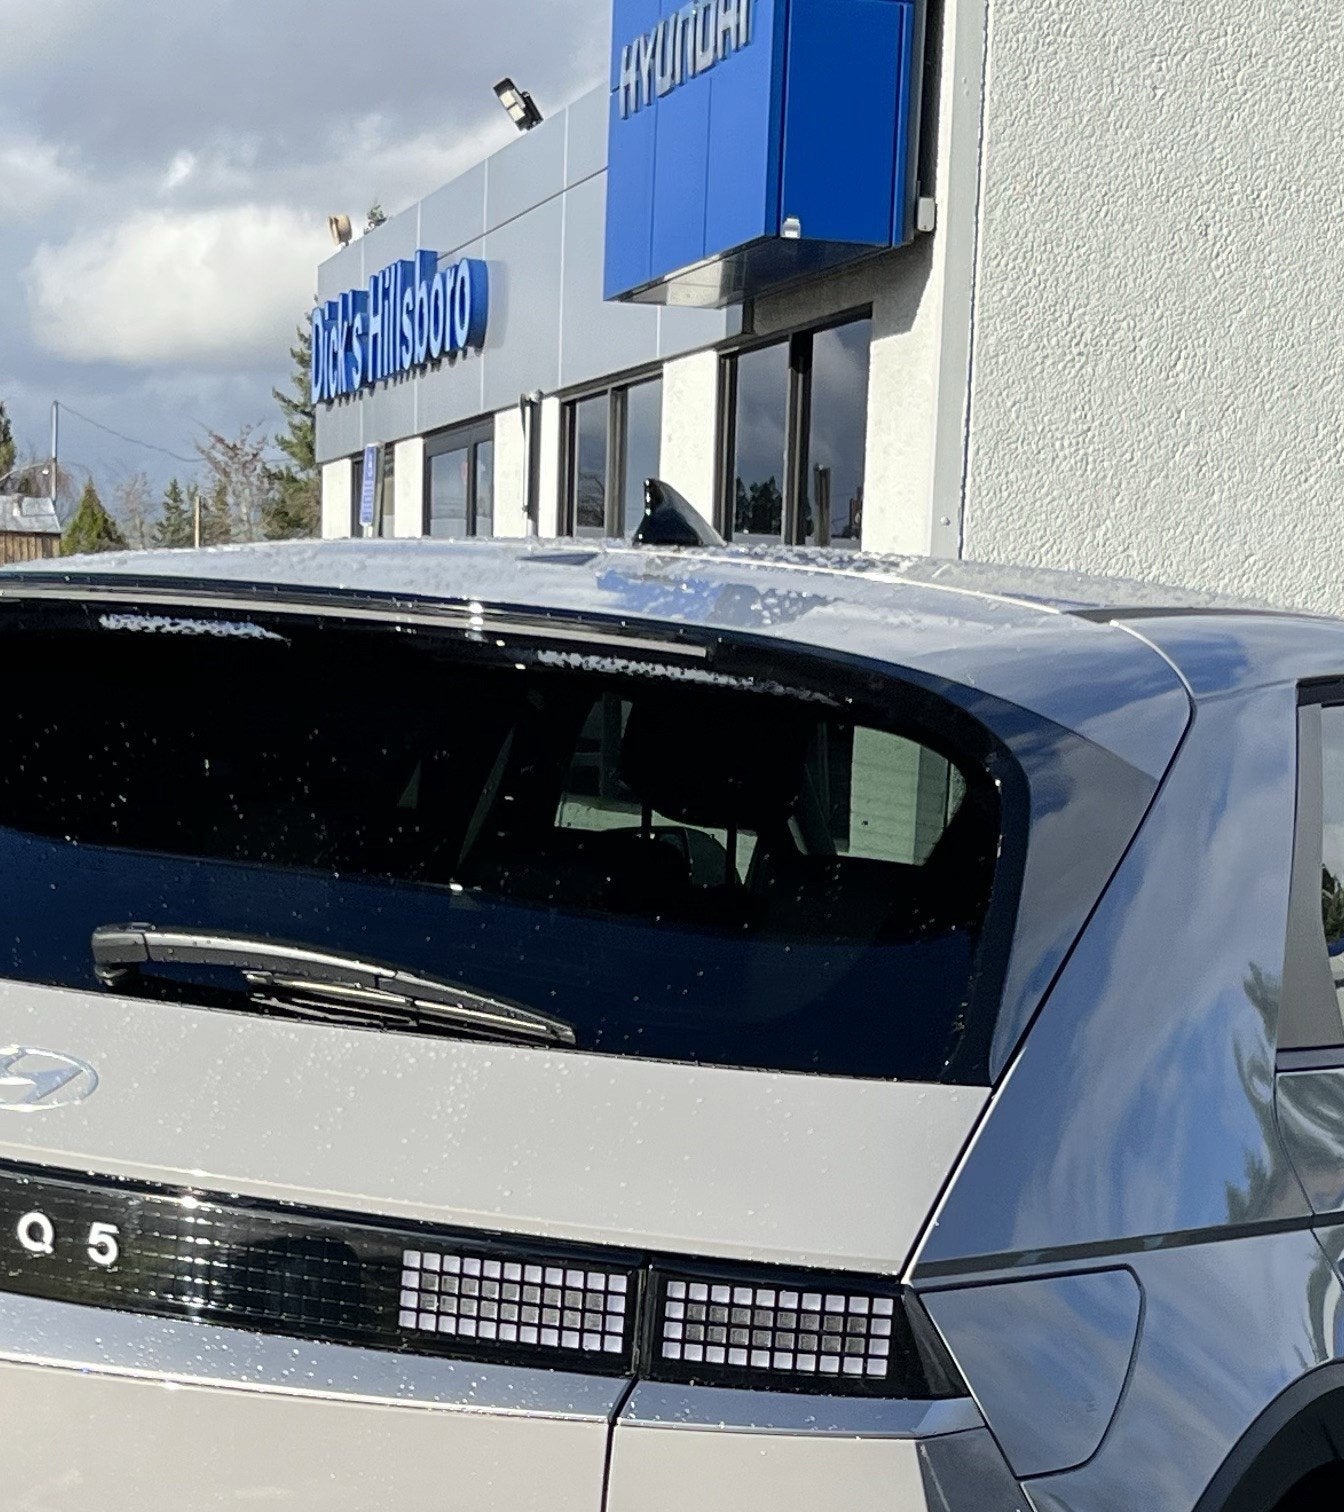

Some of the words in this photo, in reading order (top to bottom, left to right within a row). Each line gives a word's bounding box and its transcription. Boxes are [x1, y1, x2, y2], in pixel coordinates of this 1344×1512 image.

[619, 0, 752, 119] HYUNDAI
[311, 289, 365, 404] Dick's
[367, 249, 480, 383] Hillsboro
[86, 1221, 121, 1267] 5
